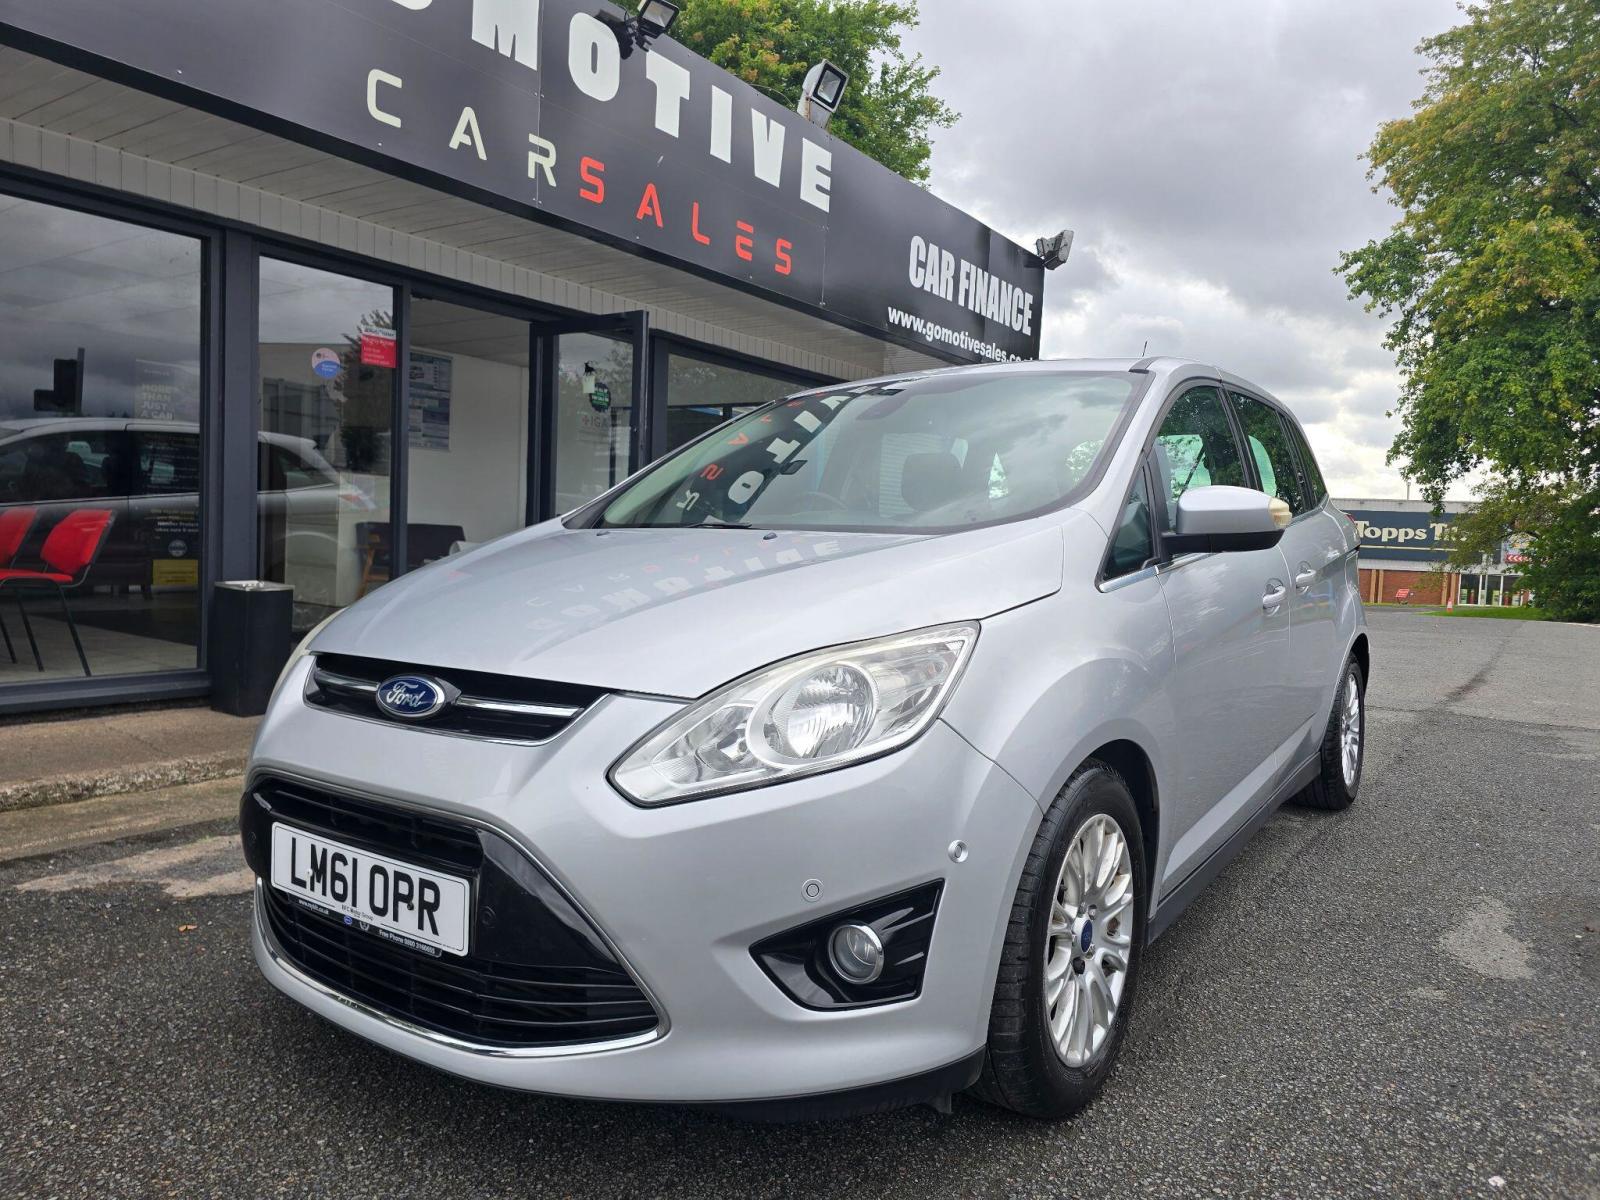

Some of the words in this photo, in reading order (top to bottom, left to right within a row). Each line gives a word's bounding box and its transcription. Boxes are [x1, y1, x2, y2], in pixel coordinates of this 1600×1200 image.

[391, 0, 832, 213] MOTIVE
[908, 235, 956, 302] CAR
[958, 259, 1034, 336] FINANCE
[1354, 520, 1428, 543] Topps
[386, 681, 427, 708] Ford
[290, 836, 358, 908] LM61
[369, 863, 441, 937] OPR
